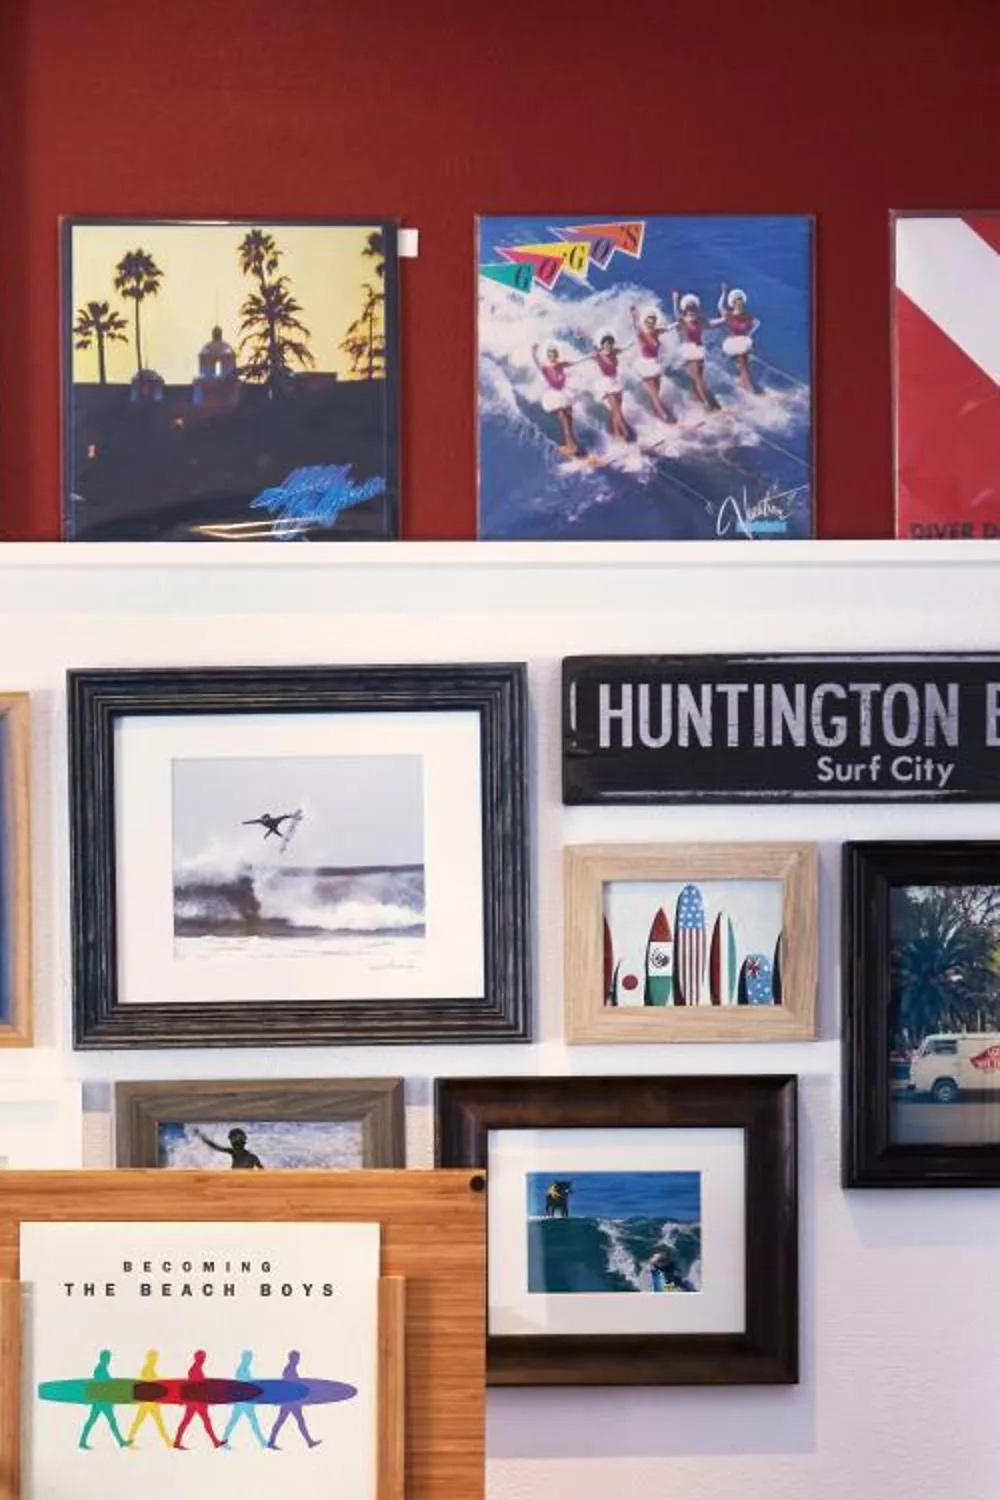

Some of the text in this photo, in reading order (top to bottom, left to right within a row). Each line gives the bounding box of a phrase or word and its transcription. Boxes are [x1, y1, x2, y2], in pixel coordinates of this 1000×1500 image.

[599, 683, 959, 749] HUNTINGTON
[816, 755, 955, 788] Surf City
[123, 1261, 272, 1273] BECOMING
[63, 1282, 334, 1297] THE BEACH BOYS
